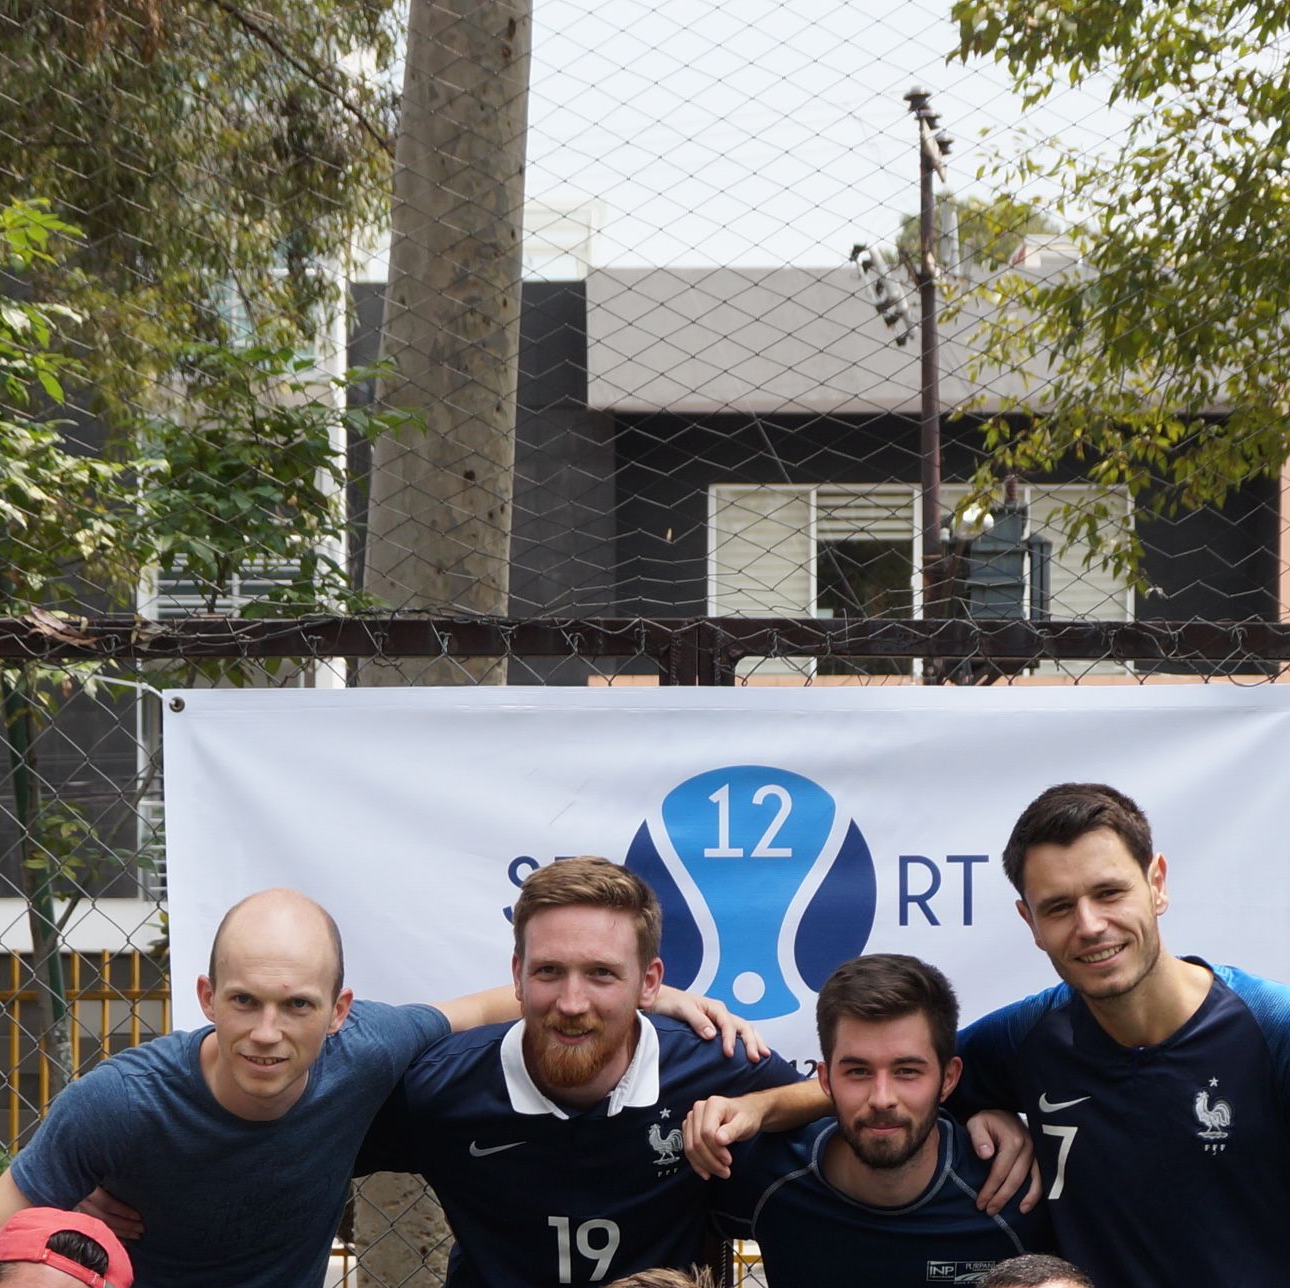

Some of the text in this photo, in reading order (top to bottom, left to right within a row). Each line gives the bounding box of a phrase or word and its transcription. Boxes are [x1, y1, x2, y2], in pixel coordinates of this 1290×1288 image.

[704, 783, 792, 858] 12
[899, 855, 989, 926] RT
[548, 1216, 620, 1284] 19
[929, 1265, 955, 1276] INP
